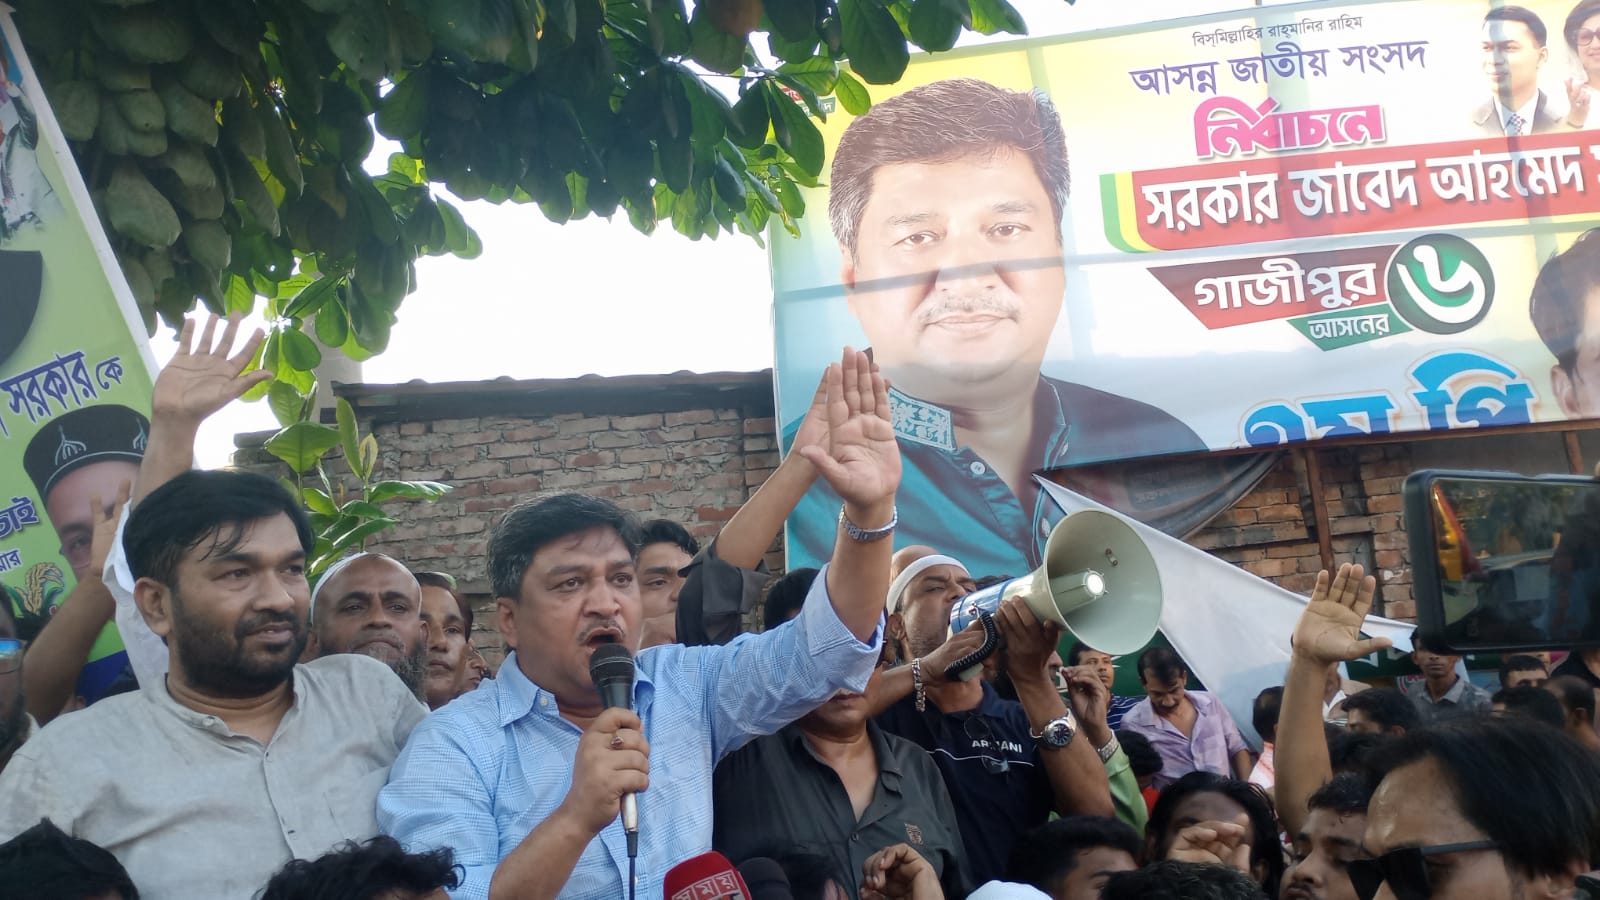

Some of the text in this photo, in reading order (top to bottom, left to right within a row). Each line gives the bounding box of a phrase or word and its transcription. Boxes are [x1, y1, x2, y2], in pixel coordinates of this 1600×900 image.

[1327, 13, 1363, 31] রাহিম
[1129, 39, 1429, 96] আসন্ন জাতীয় সংসদ
[1193, 96, 1388, 159] নির্বাচনে
[1141, 169, 1279, 231] সরকার
[1288, 159, 1418, 217] জাবেদ
[1425, 146, 1584, 208] আহমেদ
[1194, 244, 1486, 324] গাজীপুর ৬
[1307, 313, 1390, 340] আসনের
[0, 351, 123, 423] সরকার কে
[971, 739, 1023, 754] ARANI
